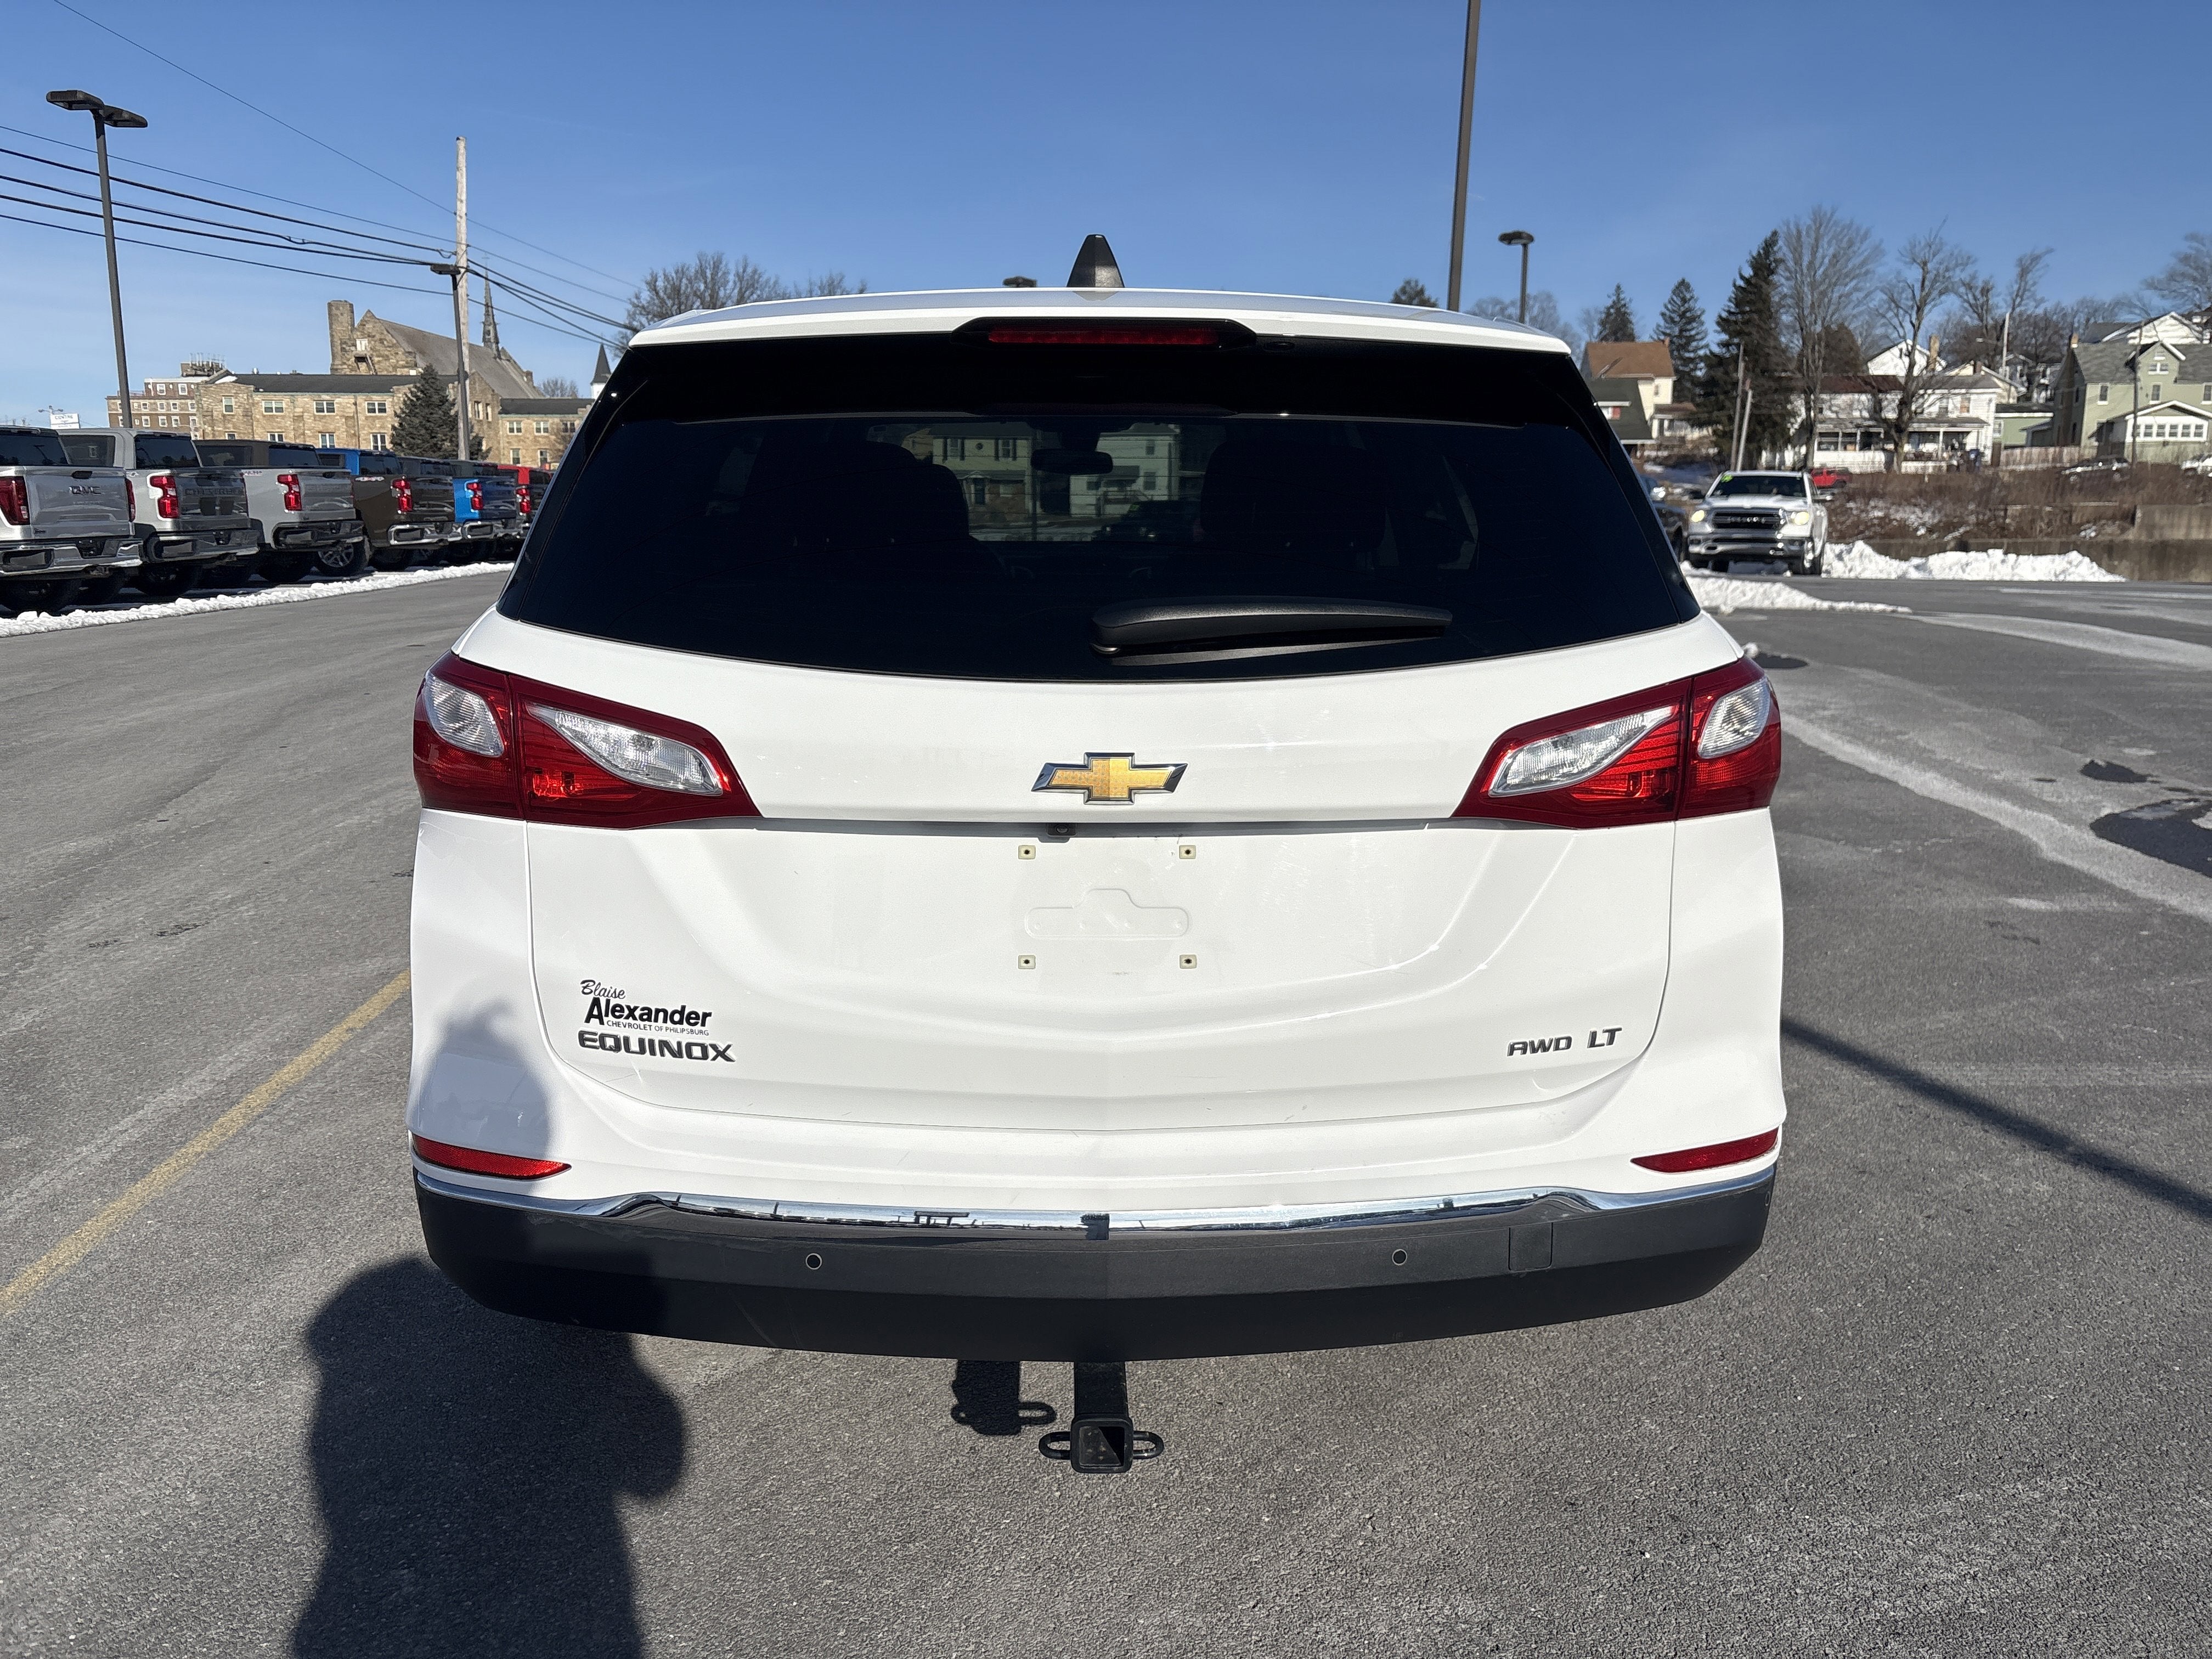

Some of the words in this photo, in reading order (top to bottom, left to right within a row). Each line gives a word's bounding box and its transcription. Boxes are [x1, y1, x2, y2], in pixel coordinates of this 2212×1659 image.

[580, 979, 626, 1000] Blaise
[584, 997, 712, 1027] Alexander
[607, 1020, 652, 1031] CHEVROLET
[665, 1026, 709, 1036] PHILIPSBURG
[1507, 1036, 1572, 1057] AWD
[1587, 1027, 1622, 1048] LT
[578, 1030, 736, 1063] EQUINOX
